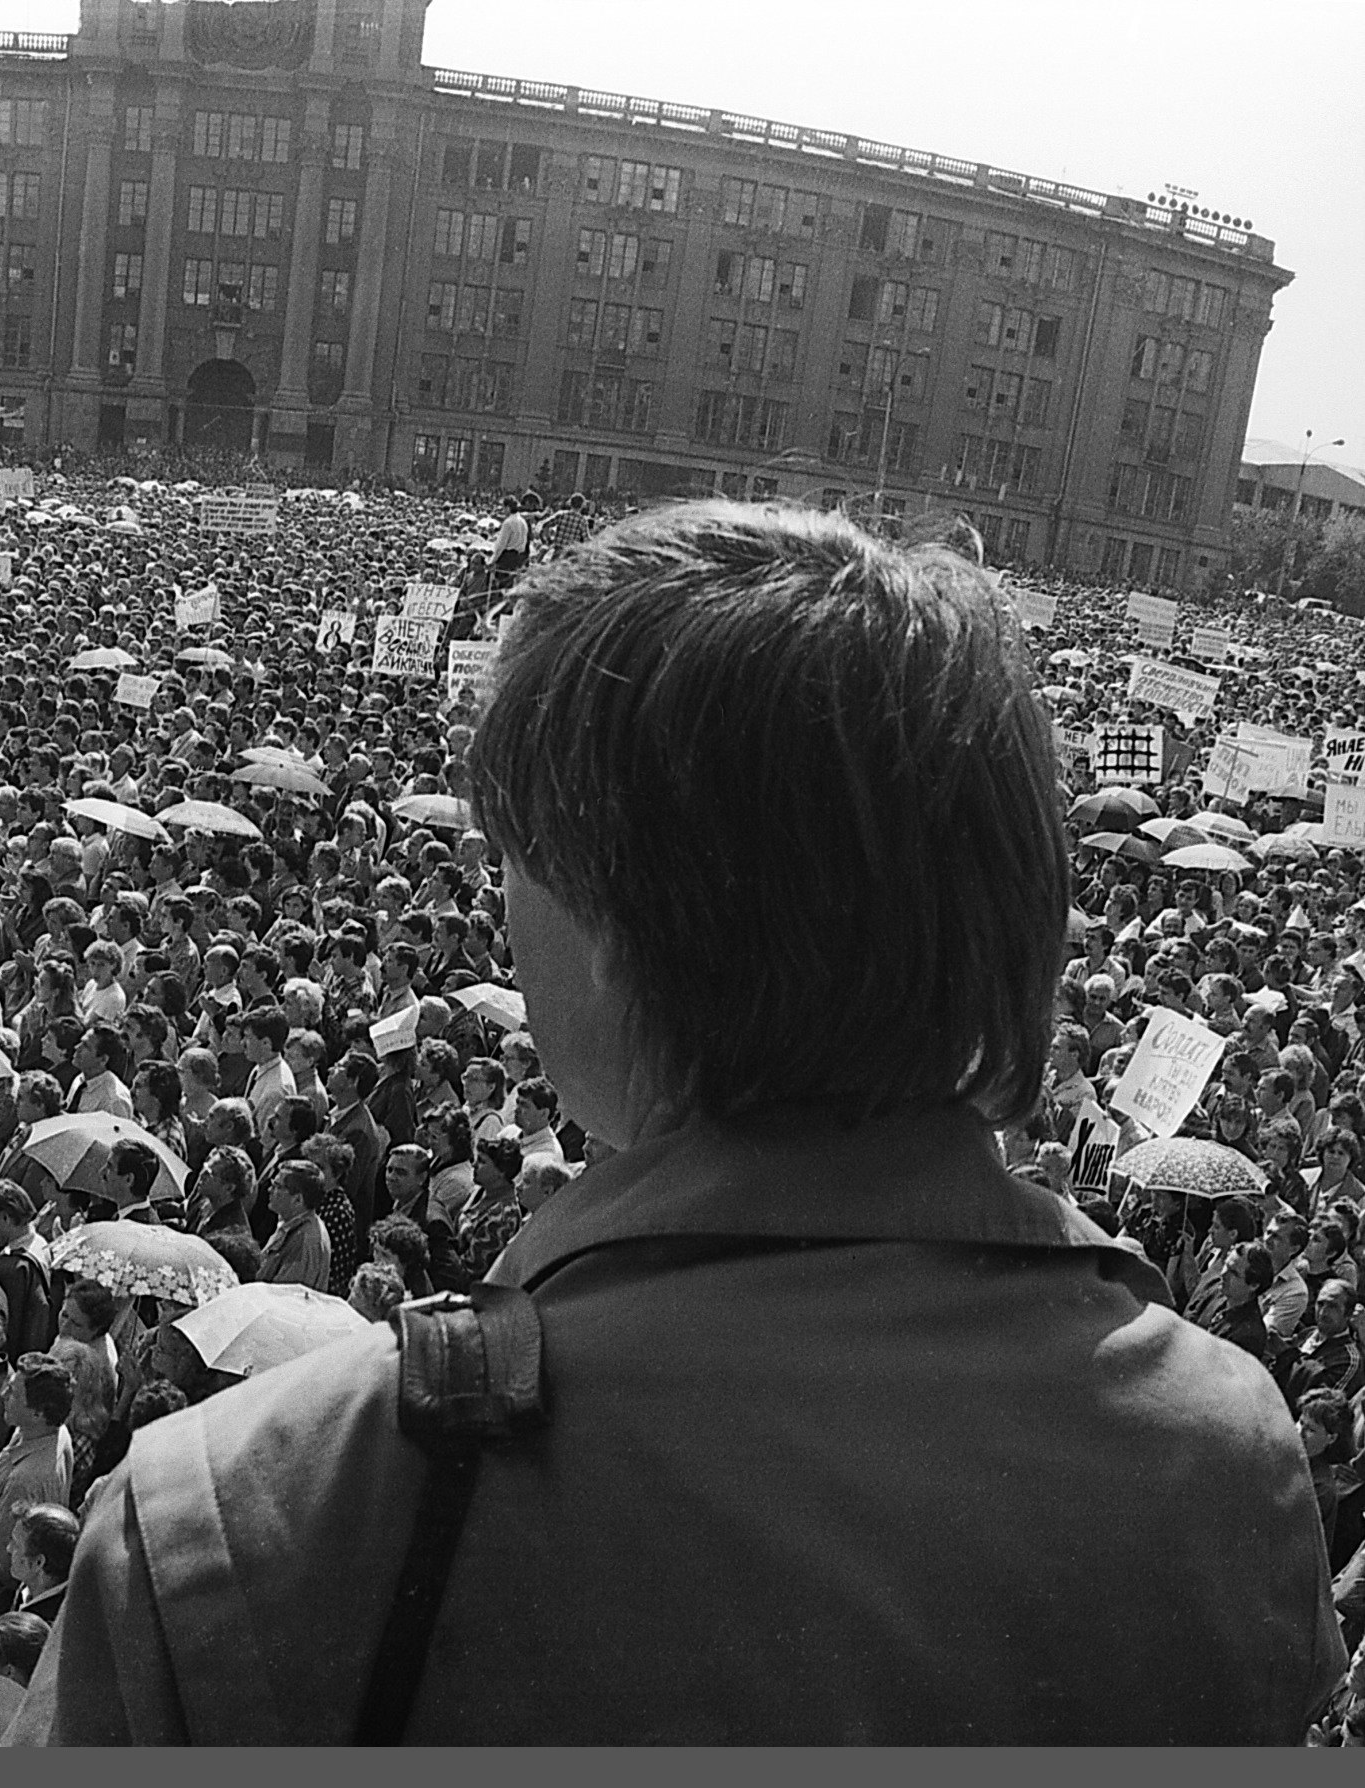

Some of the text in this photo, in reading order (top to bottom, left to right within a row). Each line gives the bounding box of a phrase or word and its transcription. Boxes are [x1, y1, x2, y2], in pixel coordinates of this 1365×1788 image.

[397, 620, 424, 640] НЕТ
[1064, 731, 1087, 745] НЕТ
[1344, 754, 1365, 771] Н
[1334, 815, 1365, 838] ЕЛЬ
